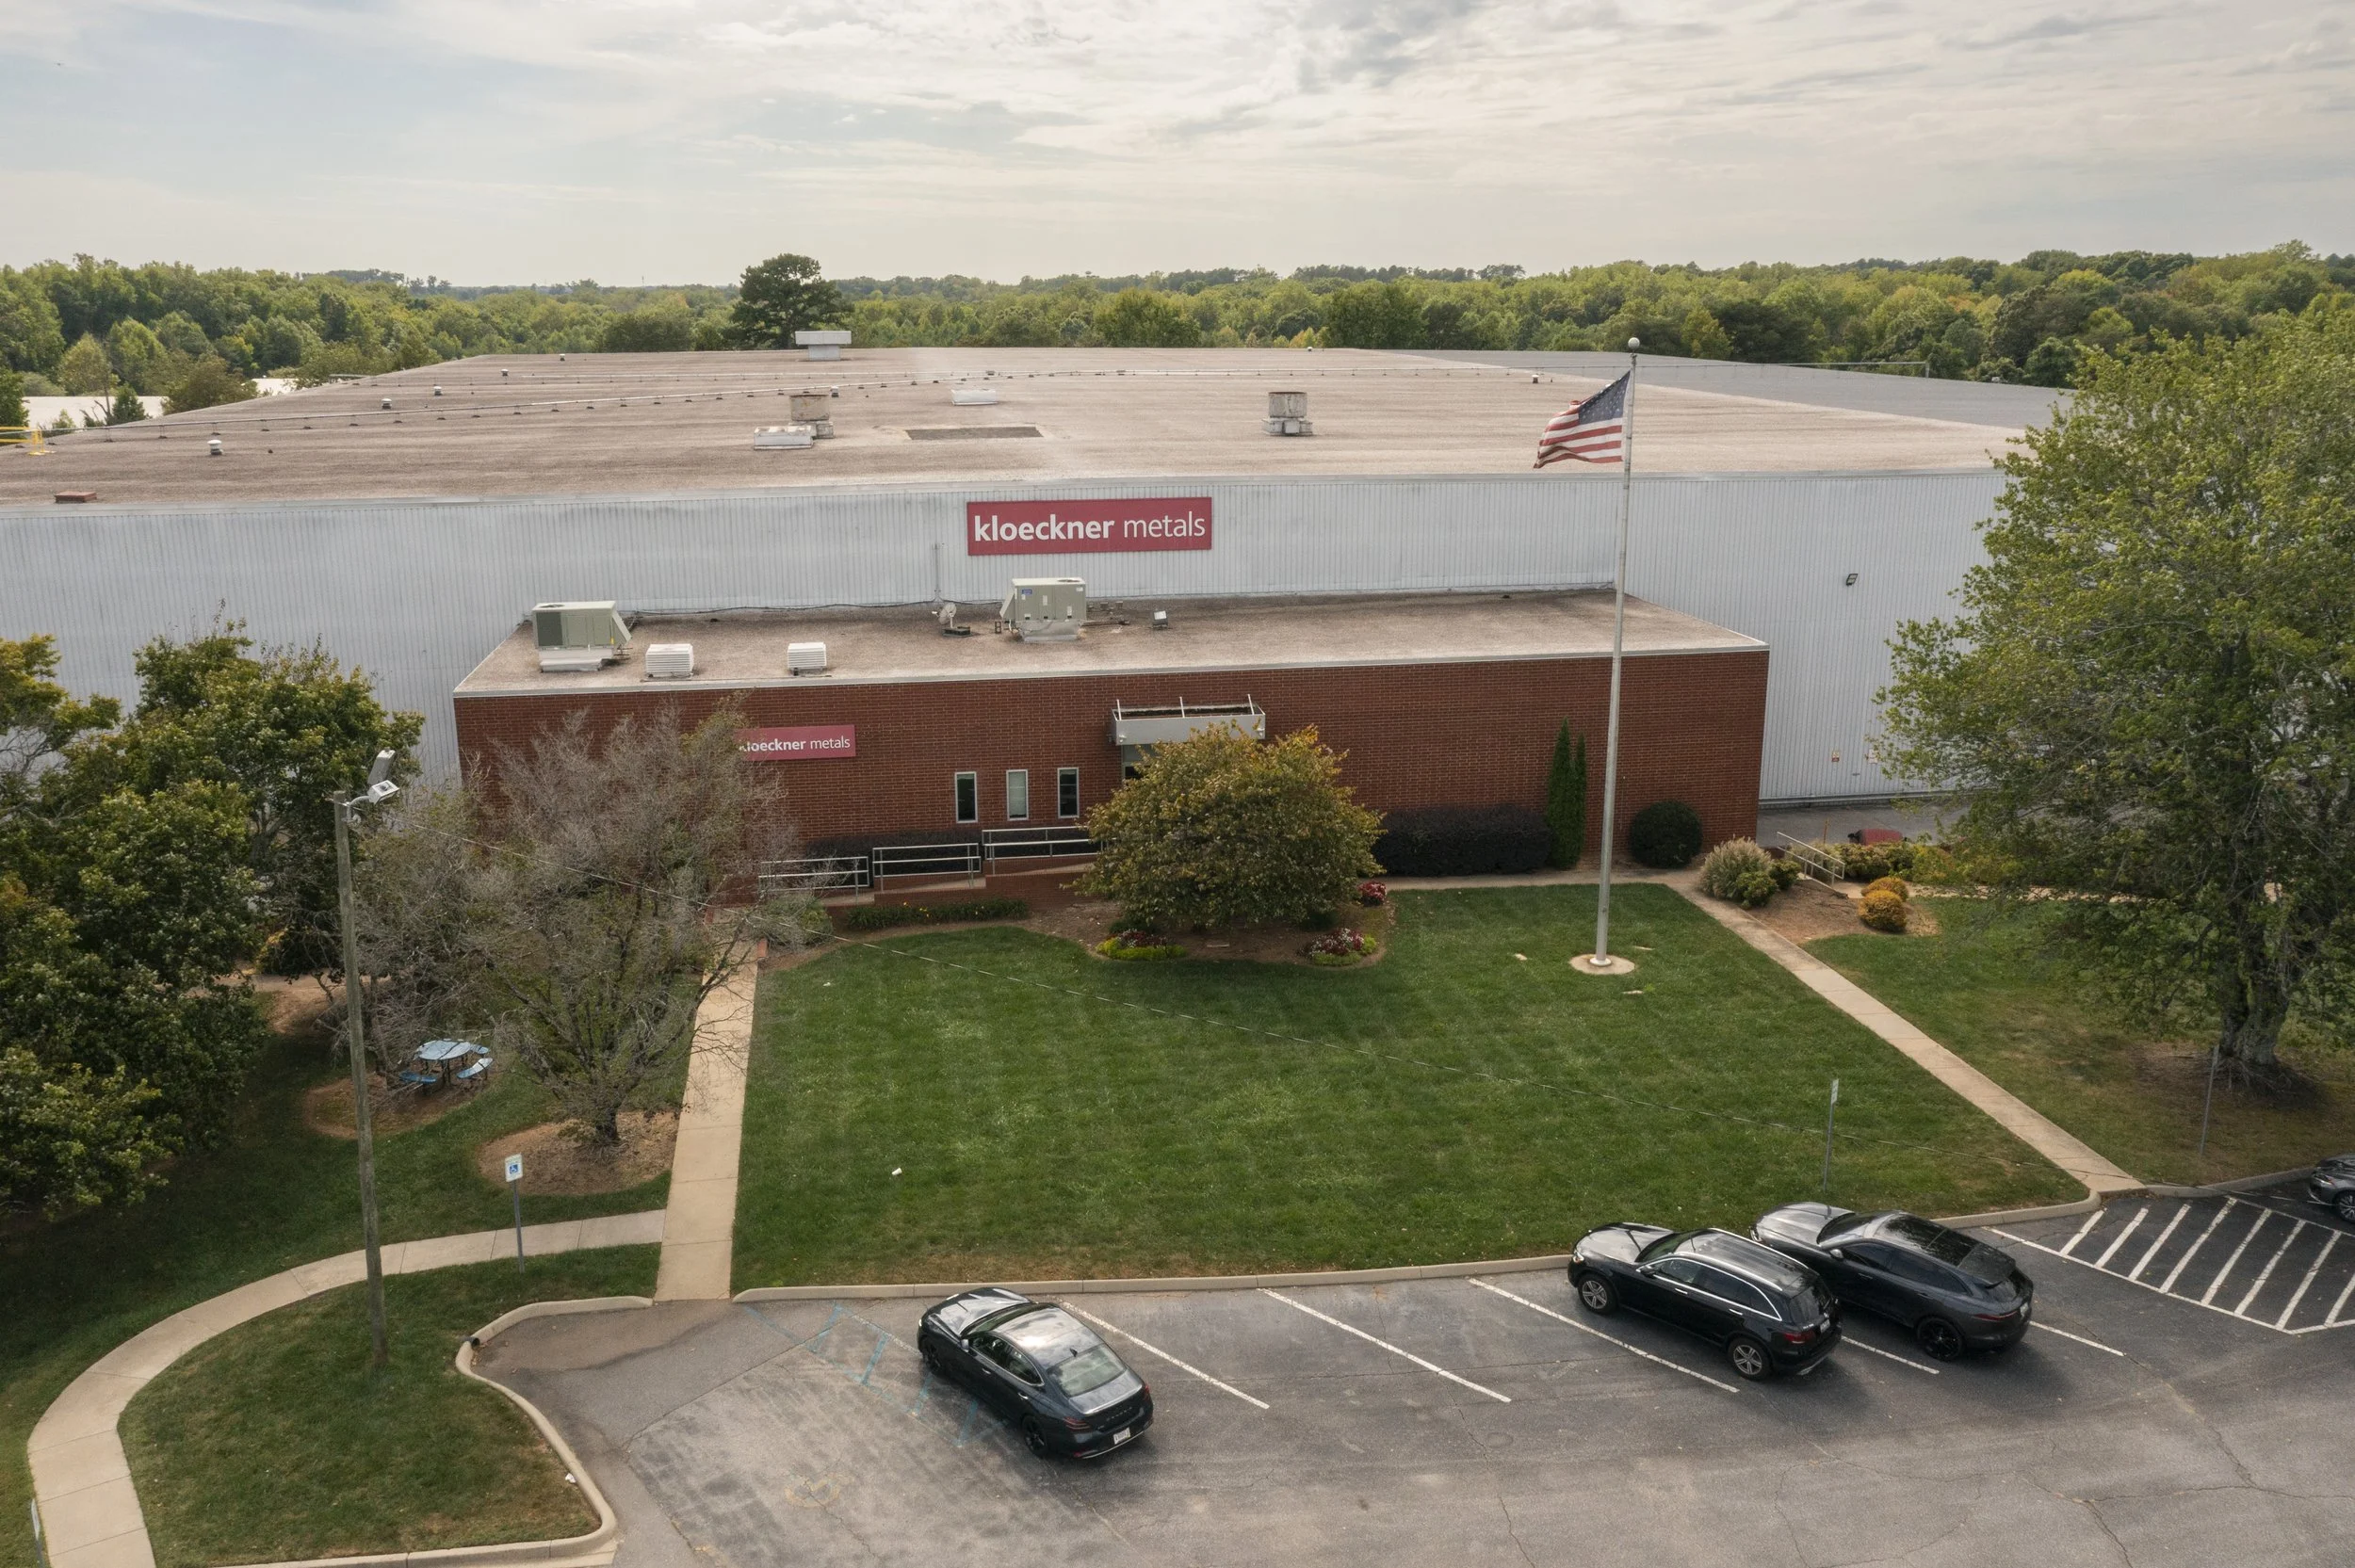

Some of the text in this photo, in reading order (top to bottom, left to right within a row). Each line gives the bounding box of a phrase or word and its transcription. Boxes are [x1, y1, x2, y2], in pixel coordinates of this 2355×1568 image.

[974, 510, 1206, 542] kloeckner metals
[810, 736, 851, 750] metals
